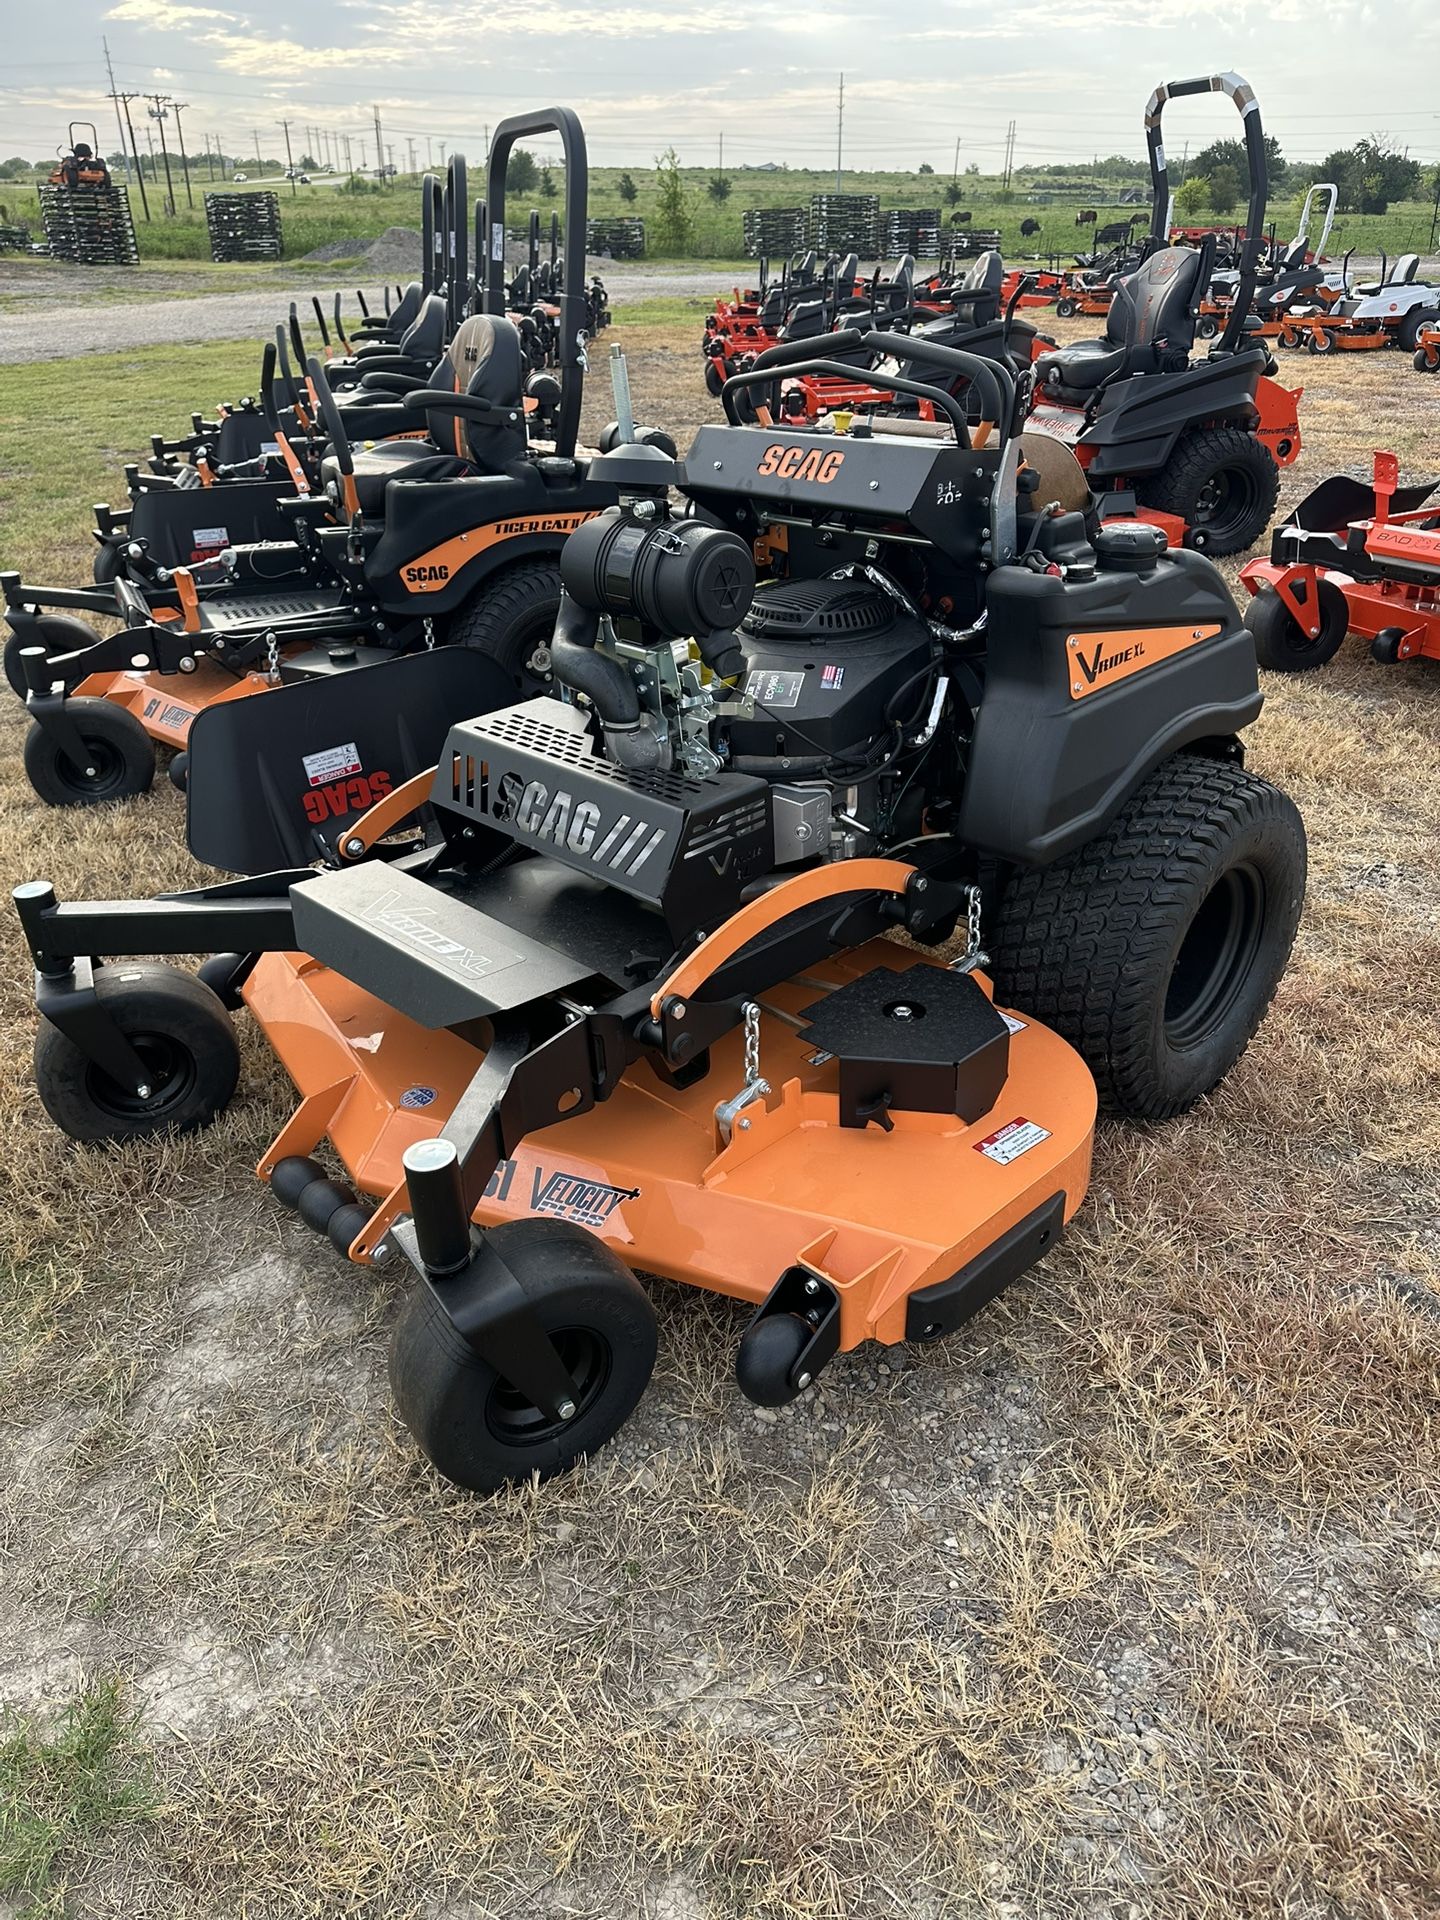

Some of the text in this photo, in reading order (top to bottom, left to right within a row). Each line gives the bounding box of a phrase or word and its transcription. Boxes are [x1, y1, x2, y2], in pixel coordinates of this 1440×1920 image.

[757, 443, 845, 484] SCAG
[494, 520, 540, 534] TIGER
[1376, 532, 1412, 545] BAD
[406, 565, 449, 582] SCAG
[143, 698, 162, 718] 61
[302, 770, 393, 824] SCAG
[492, 771, 601, 855] SCAG
[993, 1122, 1020, 1140] DANGER
